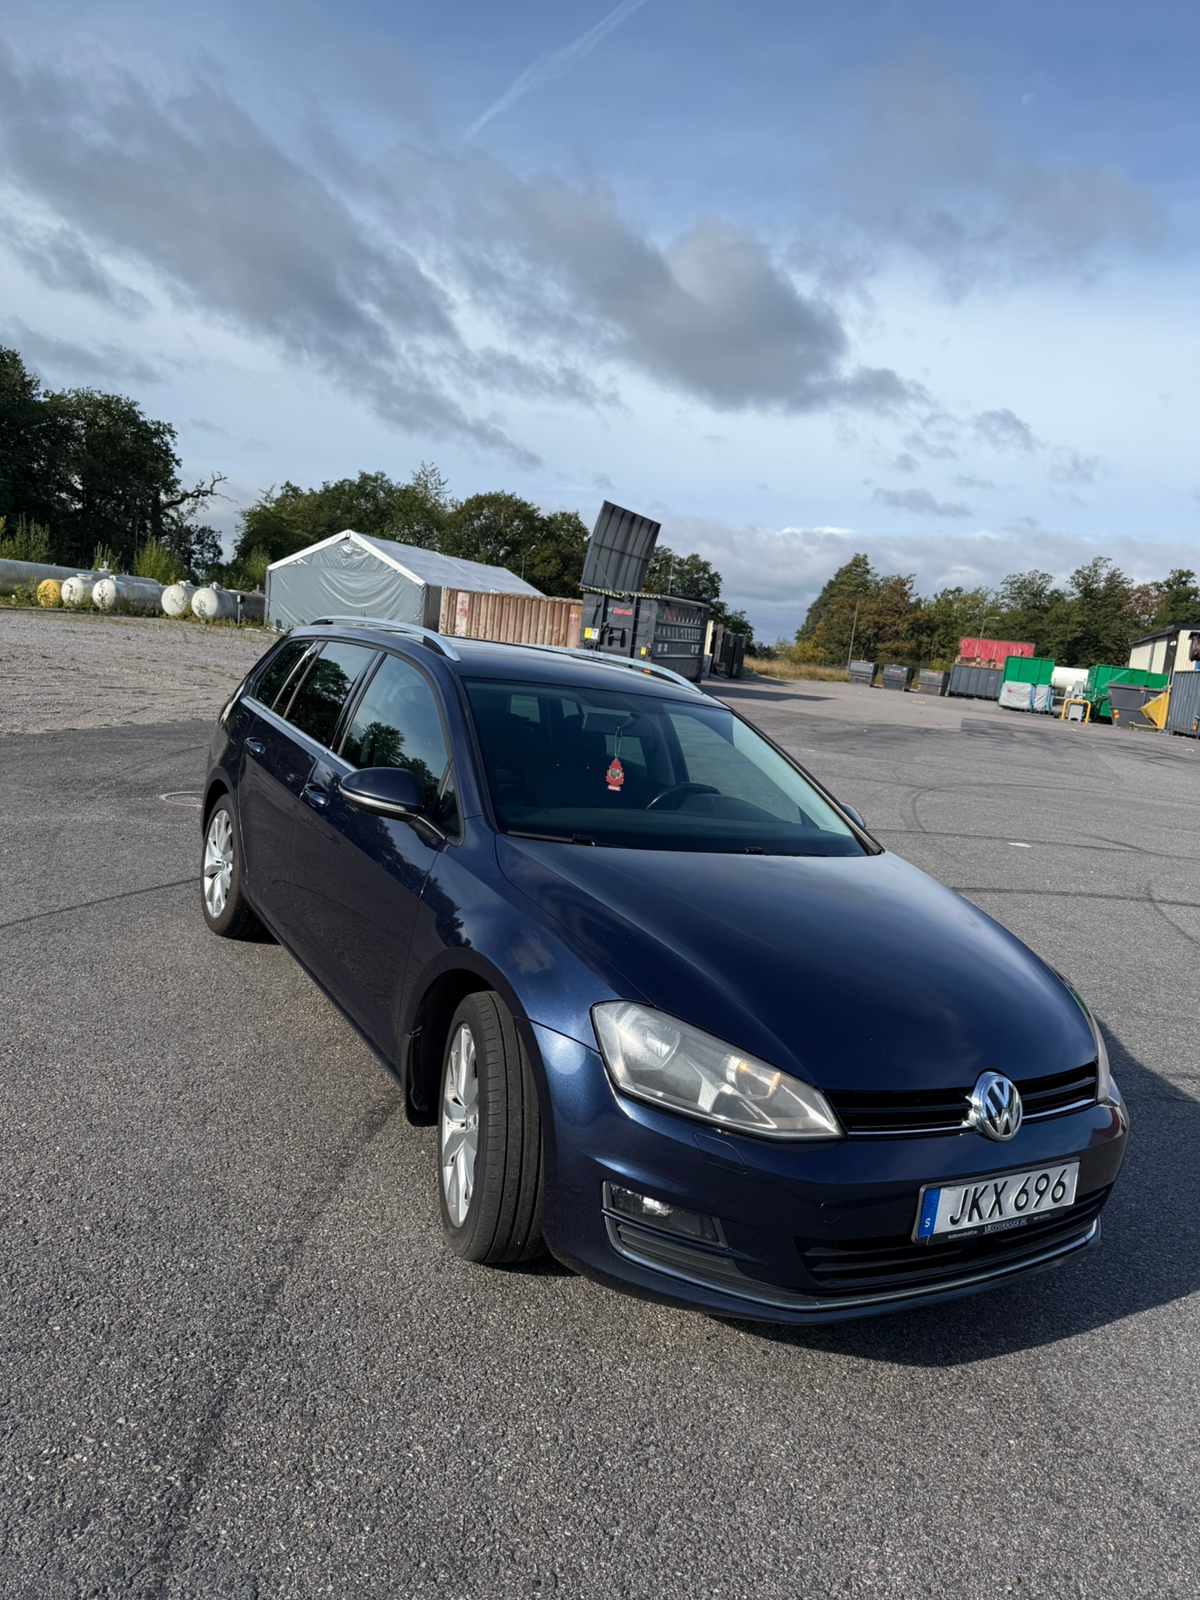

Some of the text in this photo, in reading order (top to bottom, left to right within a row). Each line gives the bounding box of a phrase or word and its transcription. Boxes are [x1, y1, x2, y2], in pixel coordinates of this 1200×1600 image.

[949, 1169, 1067, 1225] JKX 696
[924, 1218, 931, 1228] S
